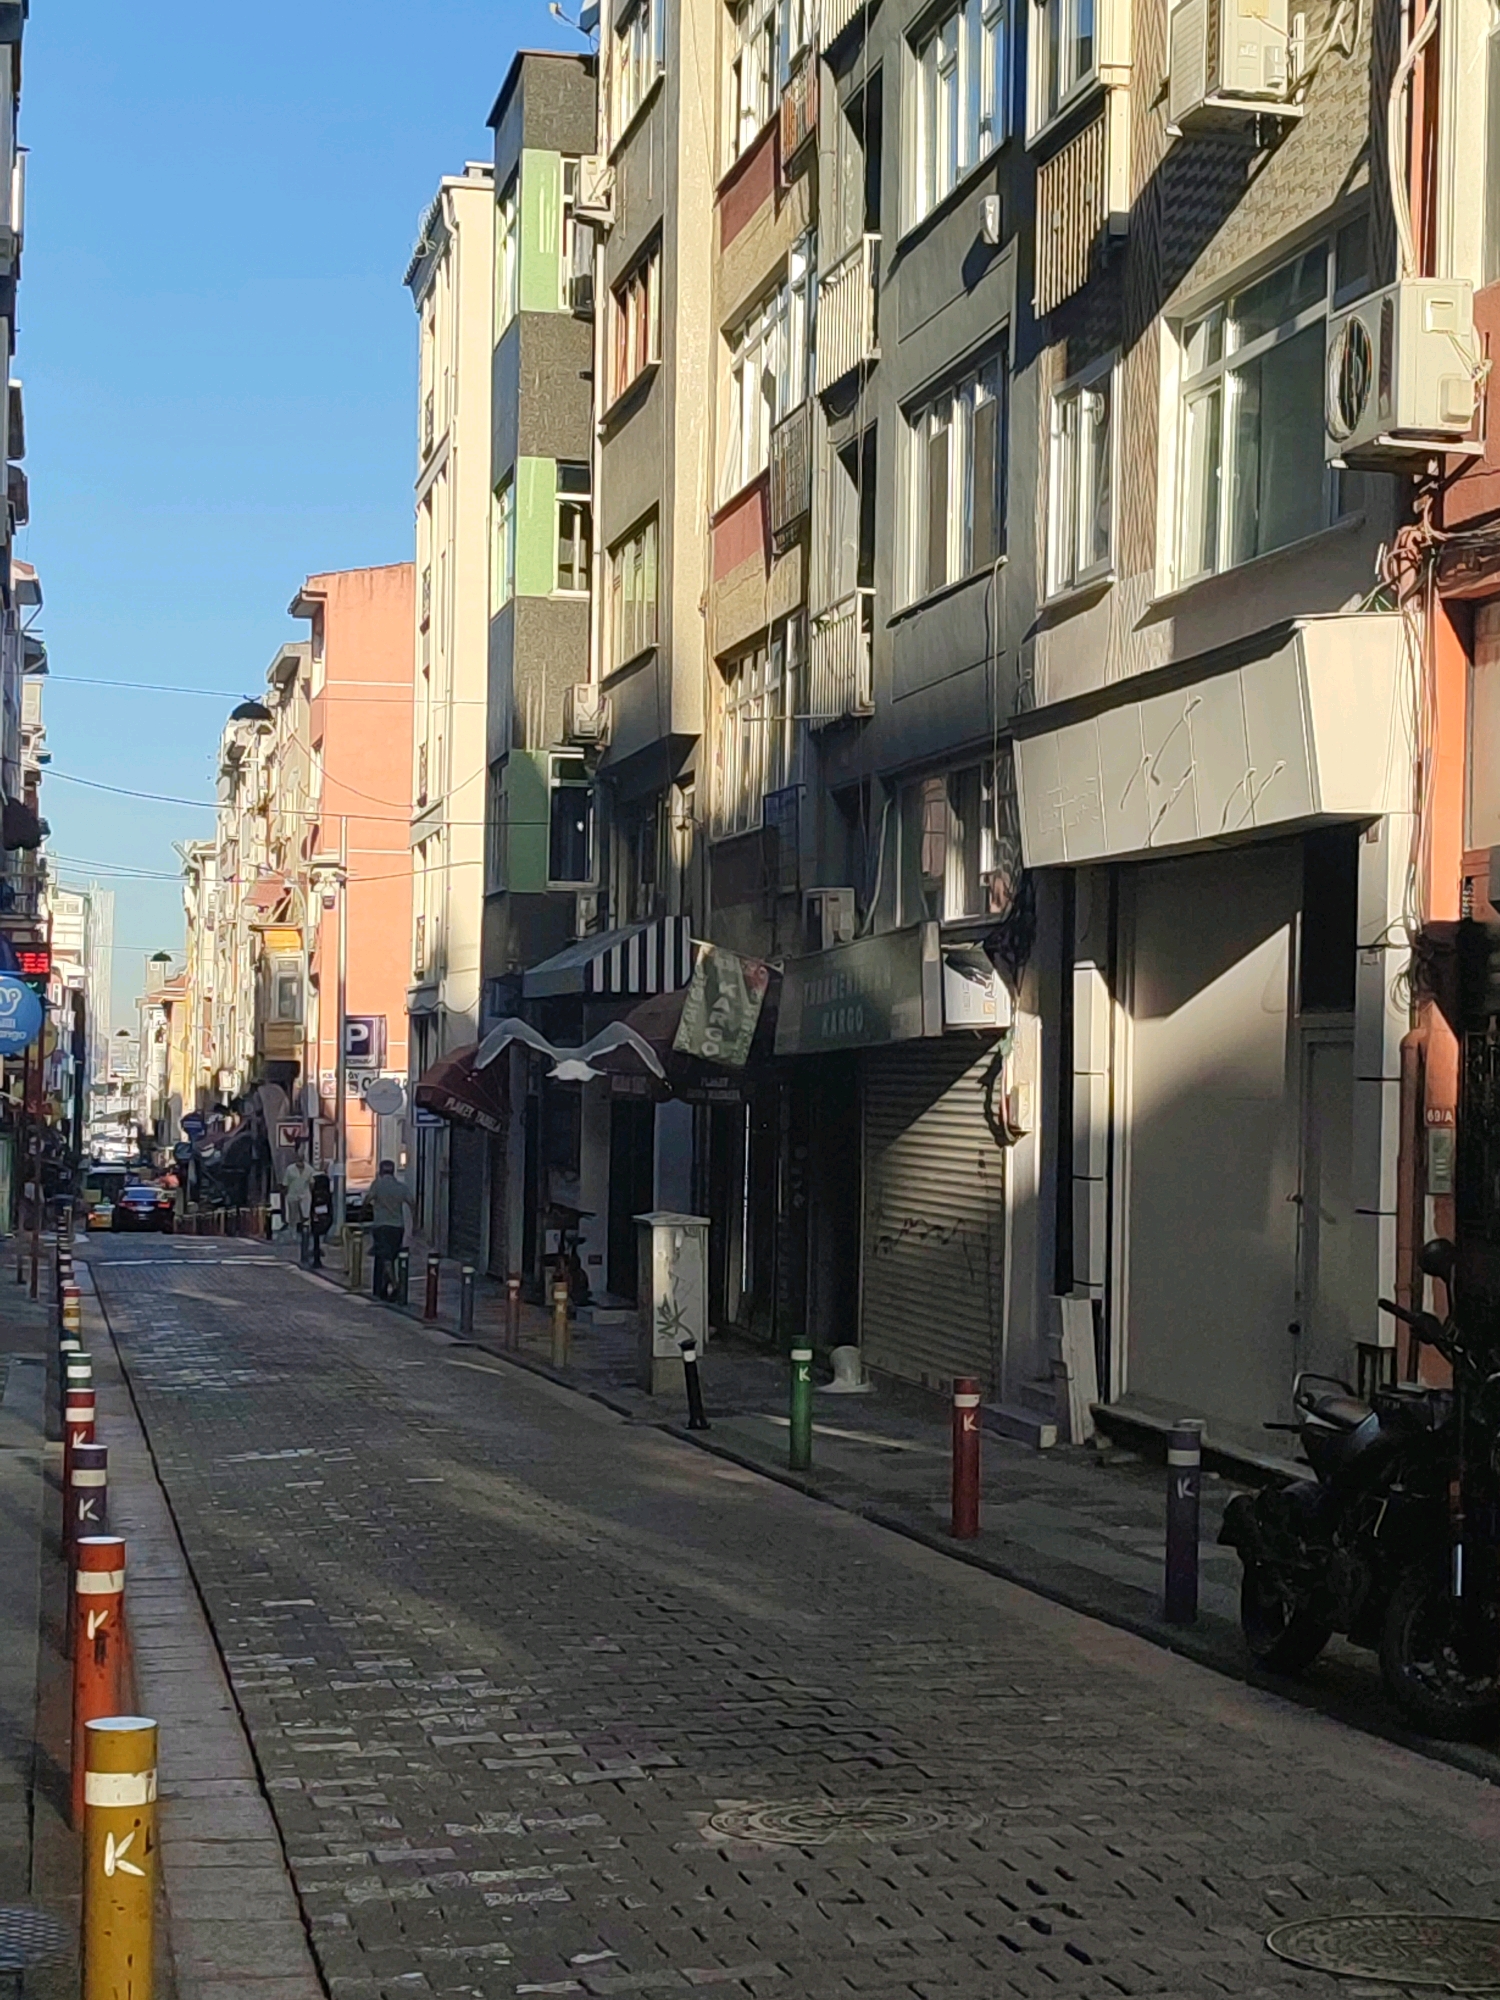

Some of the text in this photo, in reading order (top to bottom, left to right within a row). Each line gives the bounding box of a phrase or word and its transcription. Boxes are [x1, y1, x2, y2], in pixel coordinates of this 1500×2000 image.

[1207, 0, 1216, 82] VESTE
[701, 980, 737, 1057] KARGO
[820, 1004, 864, 1038] KARGO
[346, 1023, 369, 1052] P
[1427, 1110, 1454, 1122] 69/A
[798, 1365, 810, 1382] K
[963, 1413, 978, 1432] K
[1176, 1477, 1195, 1500] K
[78, 1496, 100, 1521] K
[103, 1830, 146, 1878] K
